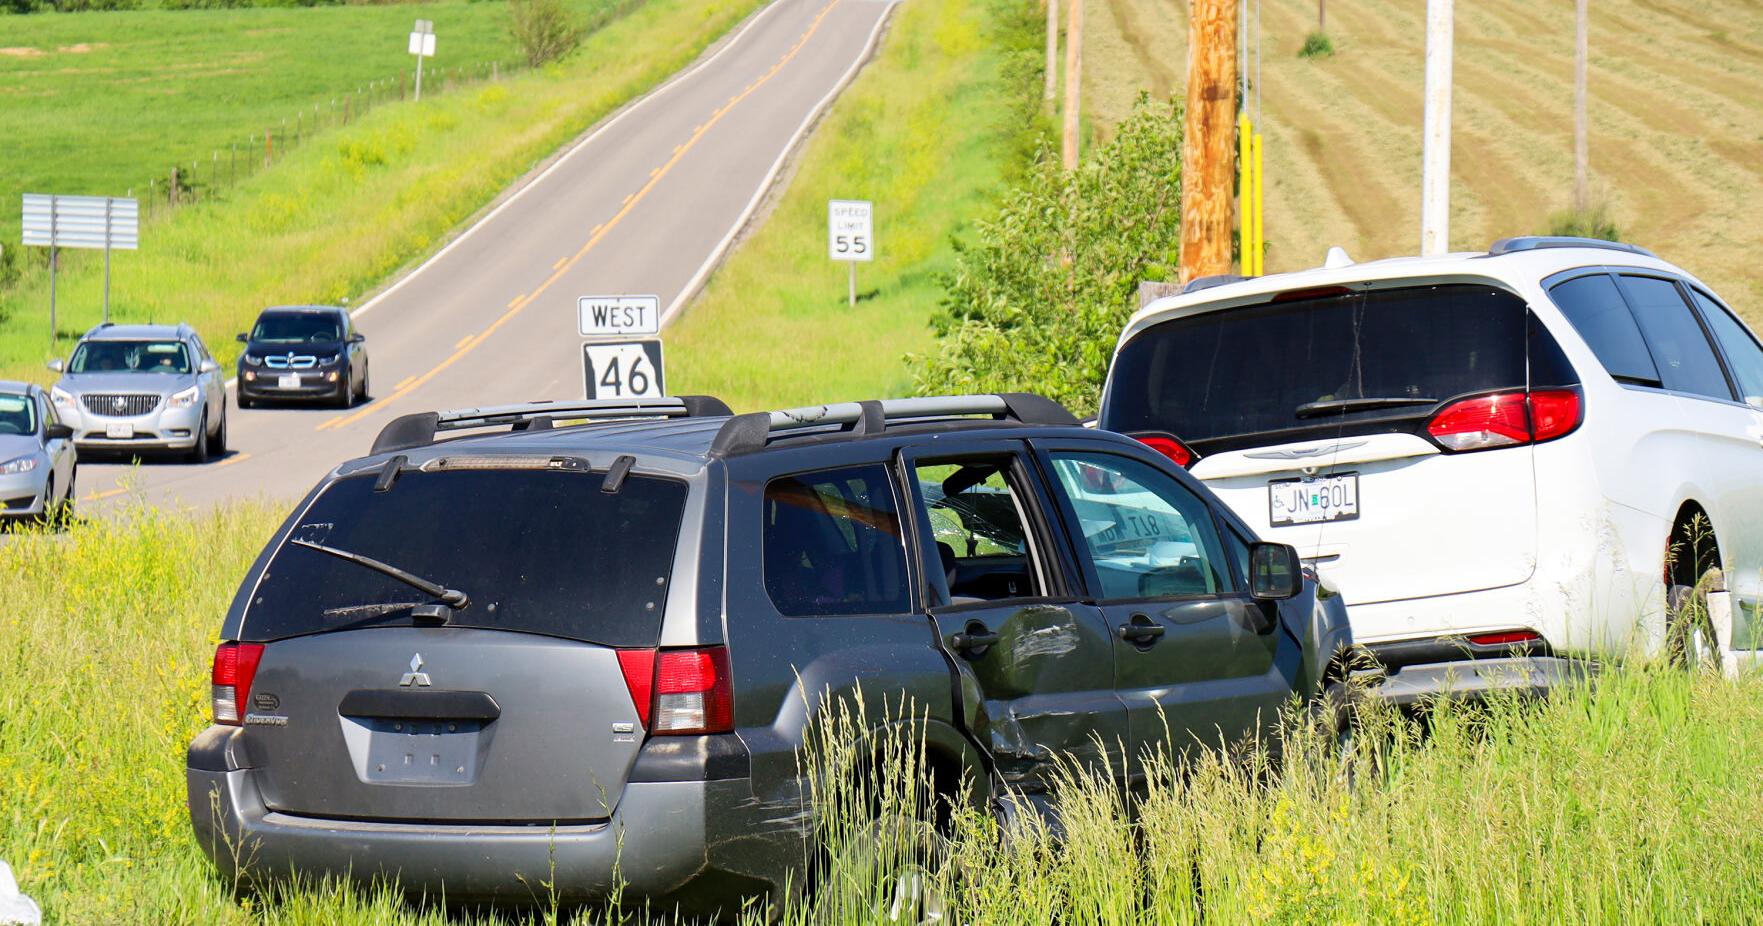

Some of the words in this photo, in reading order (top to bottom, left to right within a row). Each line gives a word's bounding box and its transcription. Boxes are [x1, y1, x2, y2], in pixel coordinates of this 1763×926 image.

[834, 208, 868, 217] SPEED
[838, 222, 864, 231] LIMIT
[836, 235, 867, 254] 55
[591, 305, 646, 328] WEST
[600, 356, 649, 397] 46
